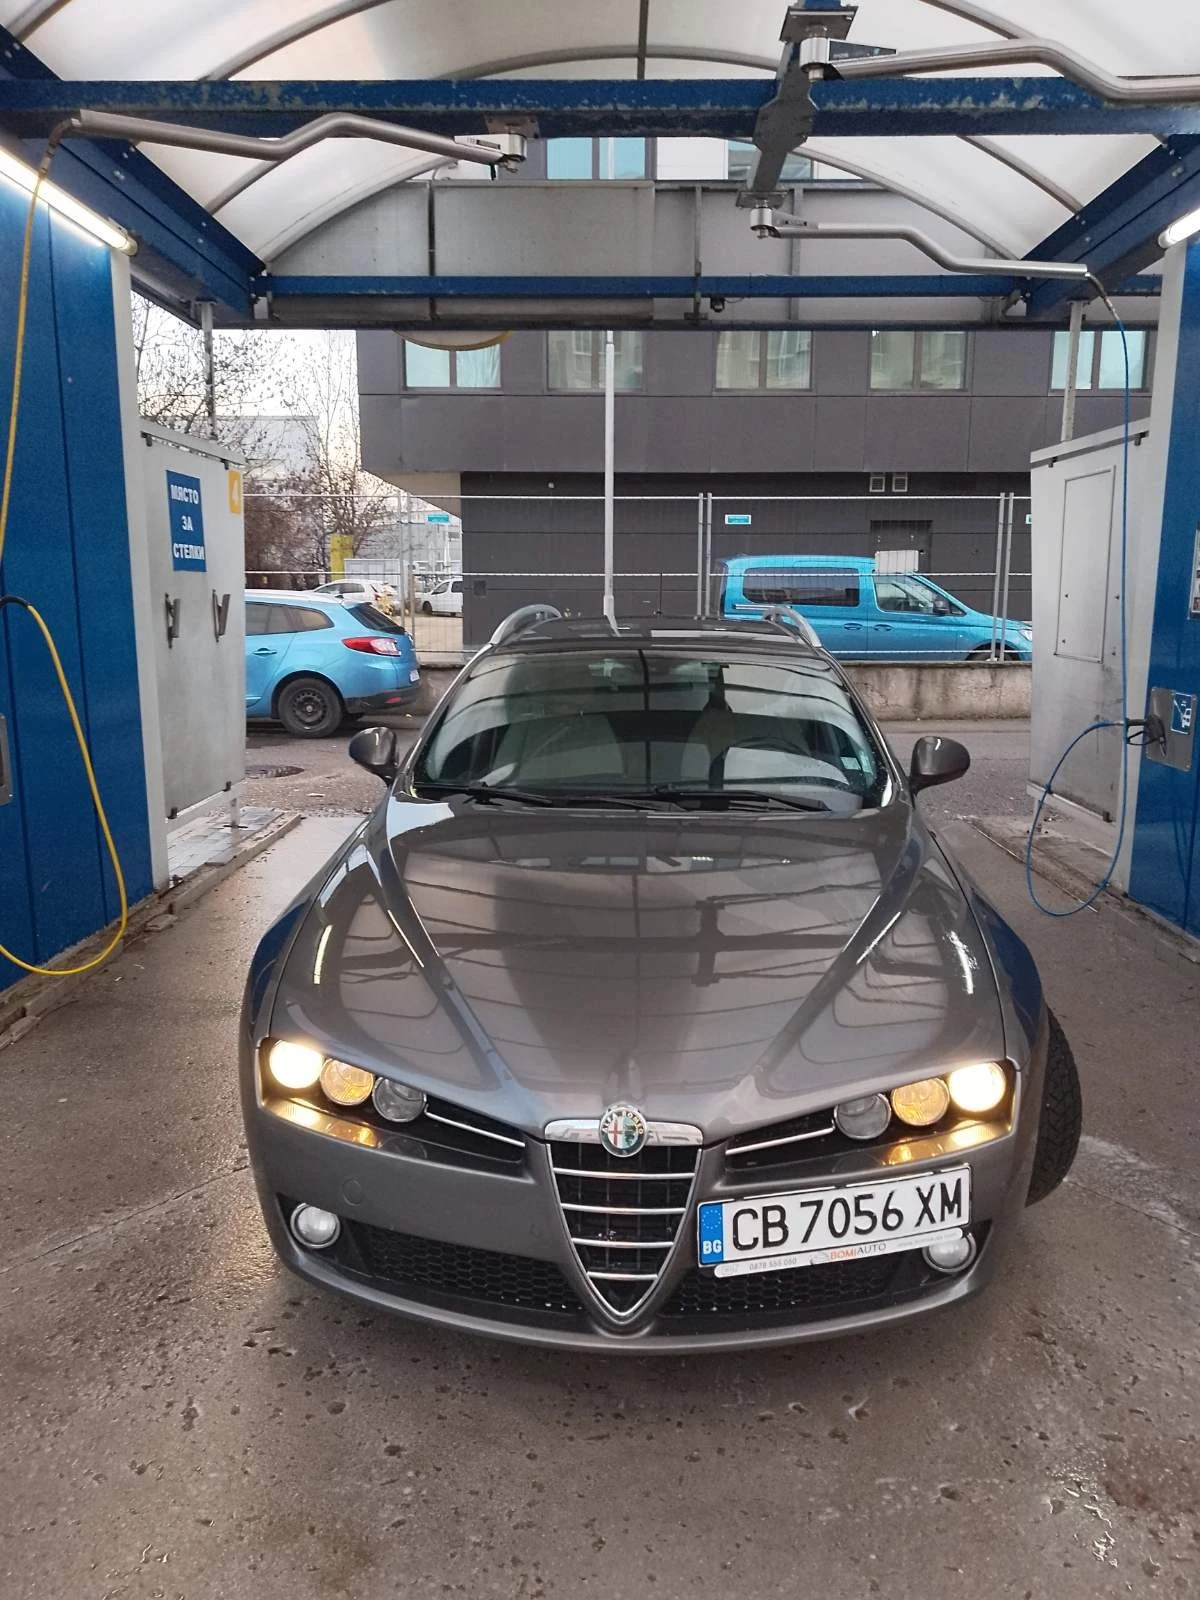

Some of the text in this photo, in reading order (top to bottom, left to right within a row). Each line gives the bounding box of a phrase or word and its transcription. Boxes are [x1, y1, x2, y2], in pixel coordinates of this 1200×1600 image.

[170, 484, 199, 505] МЯСТО
[231, 479, 240, 506] 4
[181, 515, 194, 532] ЗА
[173, 543, 205, 560] СТЕЛКИ
[732, 1204, 789, 1251] CB
[800, 1190, 904, 1244] 7056
[702, 1240, 722, 1254] BG
